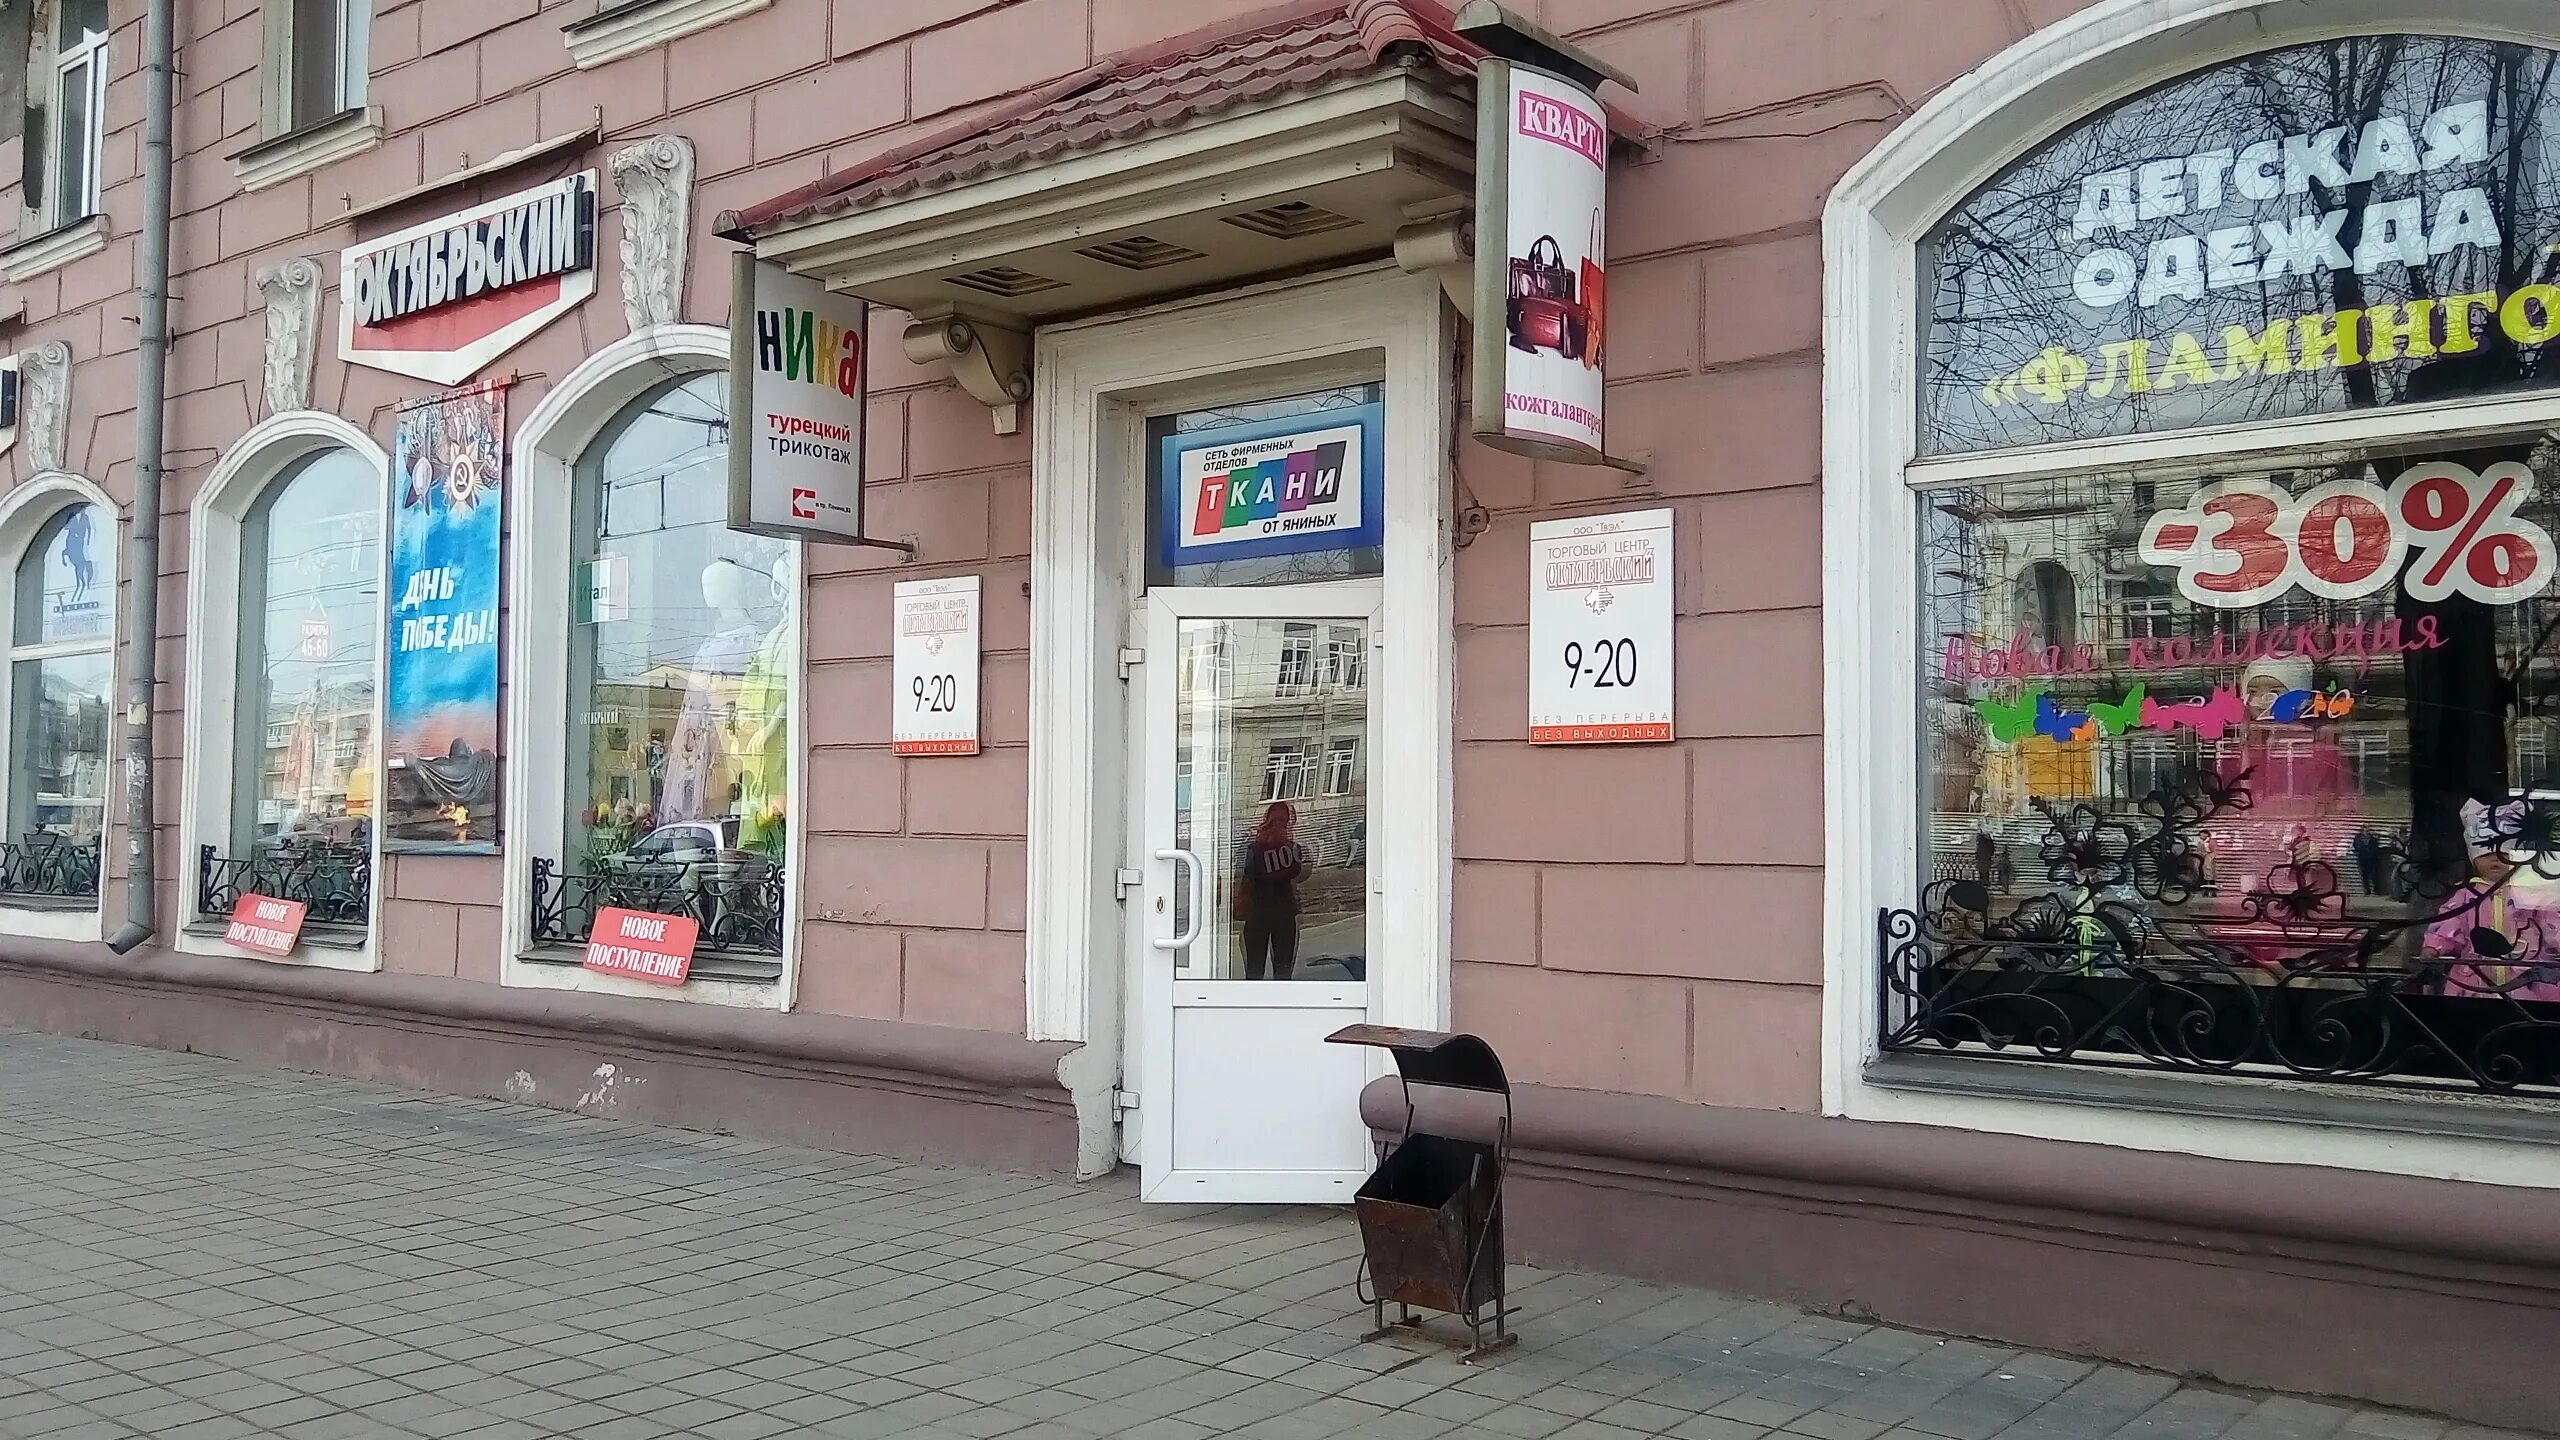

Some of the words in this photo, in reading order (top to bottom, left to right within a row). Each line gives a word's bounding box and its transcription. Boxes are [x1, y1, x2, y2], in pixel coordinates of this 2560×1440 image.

[1522, 96, 1603, 166] КВАРТА
[2069, 99, 2489, 243] ДЕТСКАЯ
[353, 176, 581, 328] ОКТЯБРЬСКИЙ
[2071, 187, 2503, 309] ОДЕЖДА
[767, 413, 852, 443] турецкий
[767, 436, 852, 465] трикотаж
[1203, 457, 1248, 472] ОТДЕЛОВ
[1205, 449, 1229, 461] СЕТЬ
[1231, 439, 1295, 457] ФИРМЕННЫХ
[1205, 467, 1337, 511] ТКАНИ
[1262, 520, 1281, 534] ОТ
[1282, 512, 1338, 532] ЯНИНЫХ
[2146, 468, 2548, 601] -30%
[1547, 541, 1607, 560] ТОРГОВЫЙ
[1614, 538, 1651, 555] ЦЕНТР
[1545, 548, 1655, 589] ОКТЯБРЬСКИЙ
[400, 566, 456, 612] ДНЬ
[903, 600, 941, 613] ТОРГОВЫЙ
[944, 598, 967, 610] ЦЕНТР
[301, 638, 329, 658] 46-60
[1564, 637, 1638, 689] 9-20
[1944, 629, 2097, 682] Новая
[2128, 614, 2450, 680] коллекция
[912, 674, 957, 713] 9-20
[1532, 714, 1562, 725] БЕЗ
[1576, 711, 1669, 724] ПЕРЕРЫВА
[1533, 728, 1563, 740] БЕЗ
[1573, 725, 1668, 740] ВЫХОДНЫХ
[894, 733, 913, 741] БЕЗ
[920, 731, 975, 740] ПЕРЕРЫВА
[895, 744, 913, 753] БЕЗ
[918, 743, 975, 752] ВЫХОДНЫХ
[255, 900, 291, 923] НОВОЕ
[226, 921, 295, 951] ПОСТУПЛЕНИЕ
[619, 915, 670, 943] НОВОЕ
[586, 942, 687, 979] ПОСТУПЛЕНИЕ
